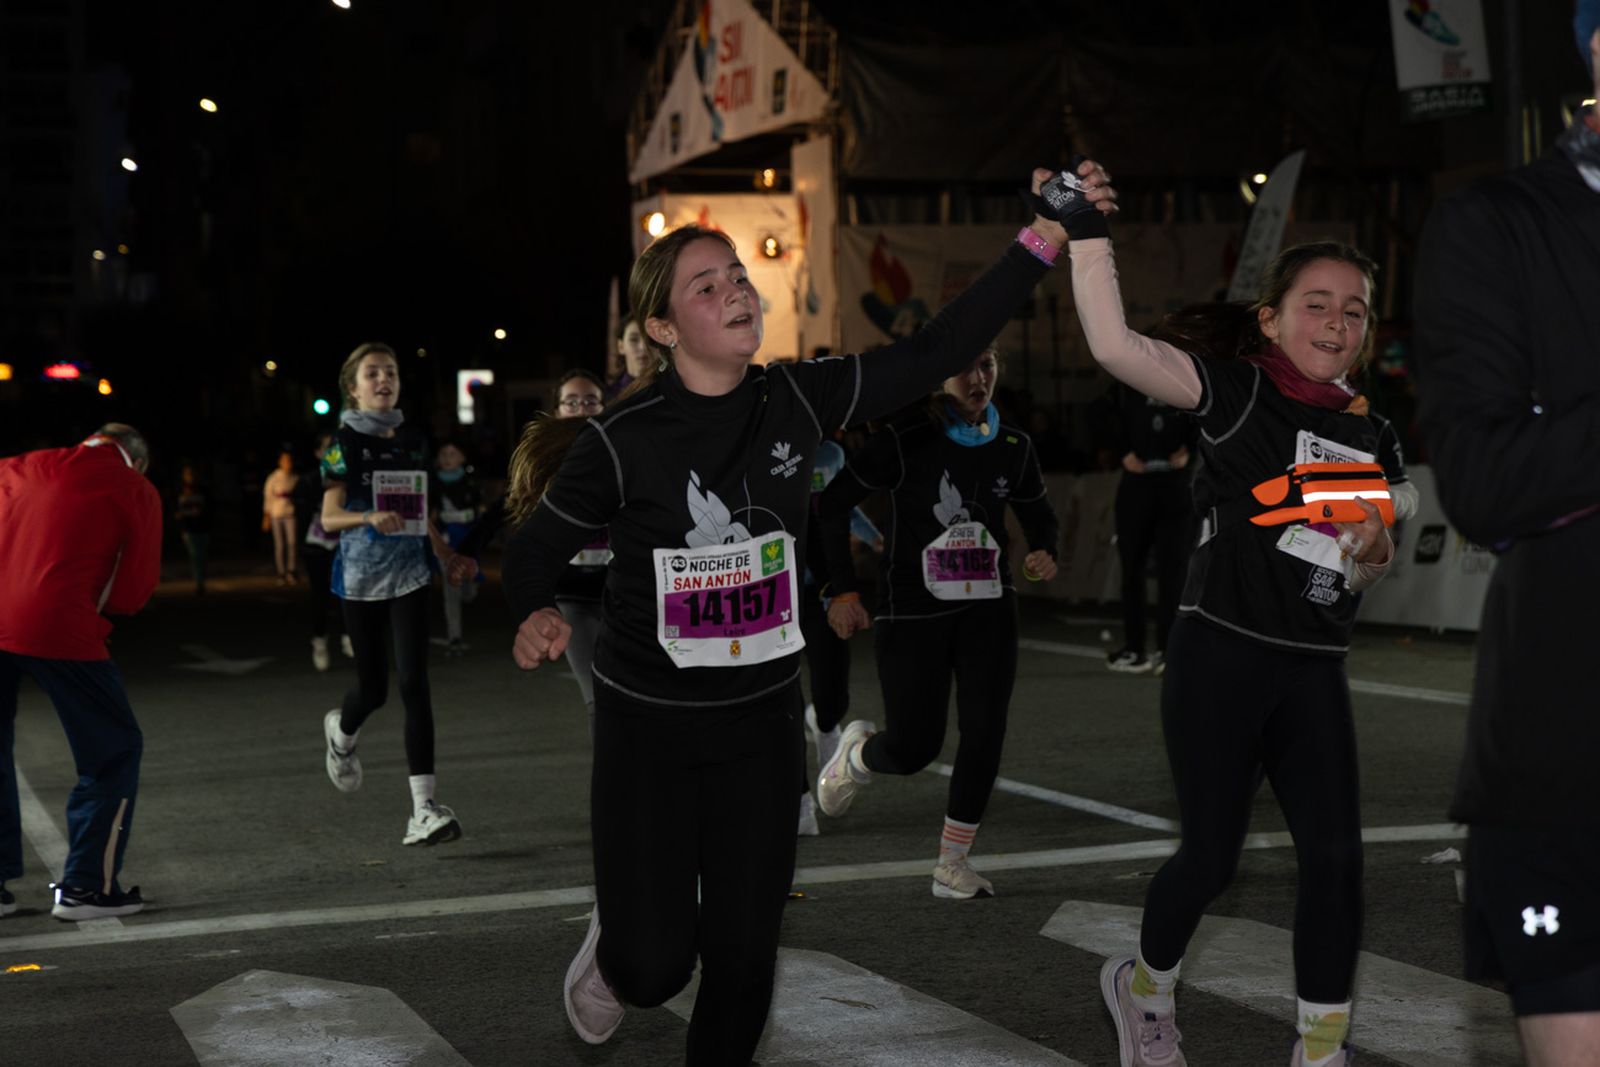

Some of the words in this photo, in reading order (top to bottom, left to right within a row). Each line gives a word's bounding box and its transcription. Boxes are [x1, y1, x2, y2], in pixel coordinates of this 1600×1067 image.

[690, 558, 732, 572] NOCHE
[736, 555, 750, 568] DE
[674, 575, 701, 591] SAN
[705, 569, 752, 588] ANTÓN
[1311, 572, 1336, 587] SAN
[683, 577, 776, 627] 14157
